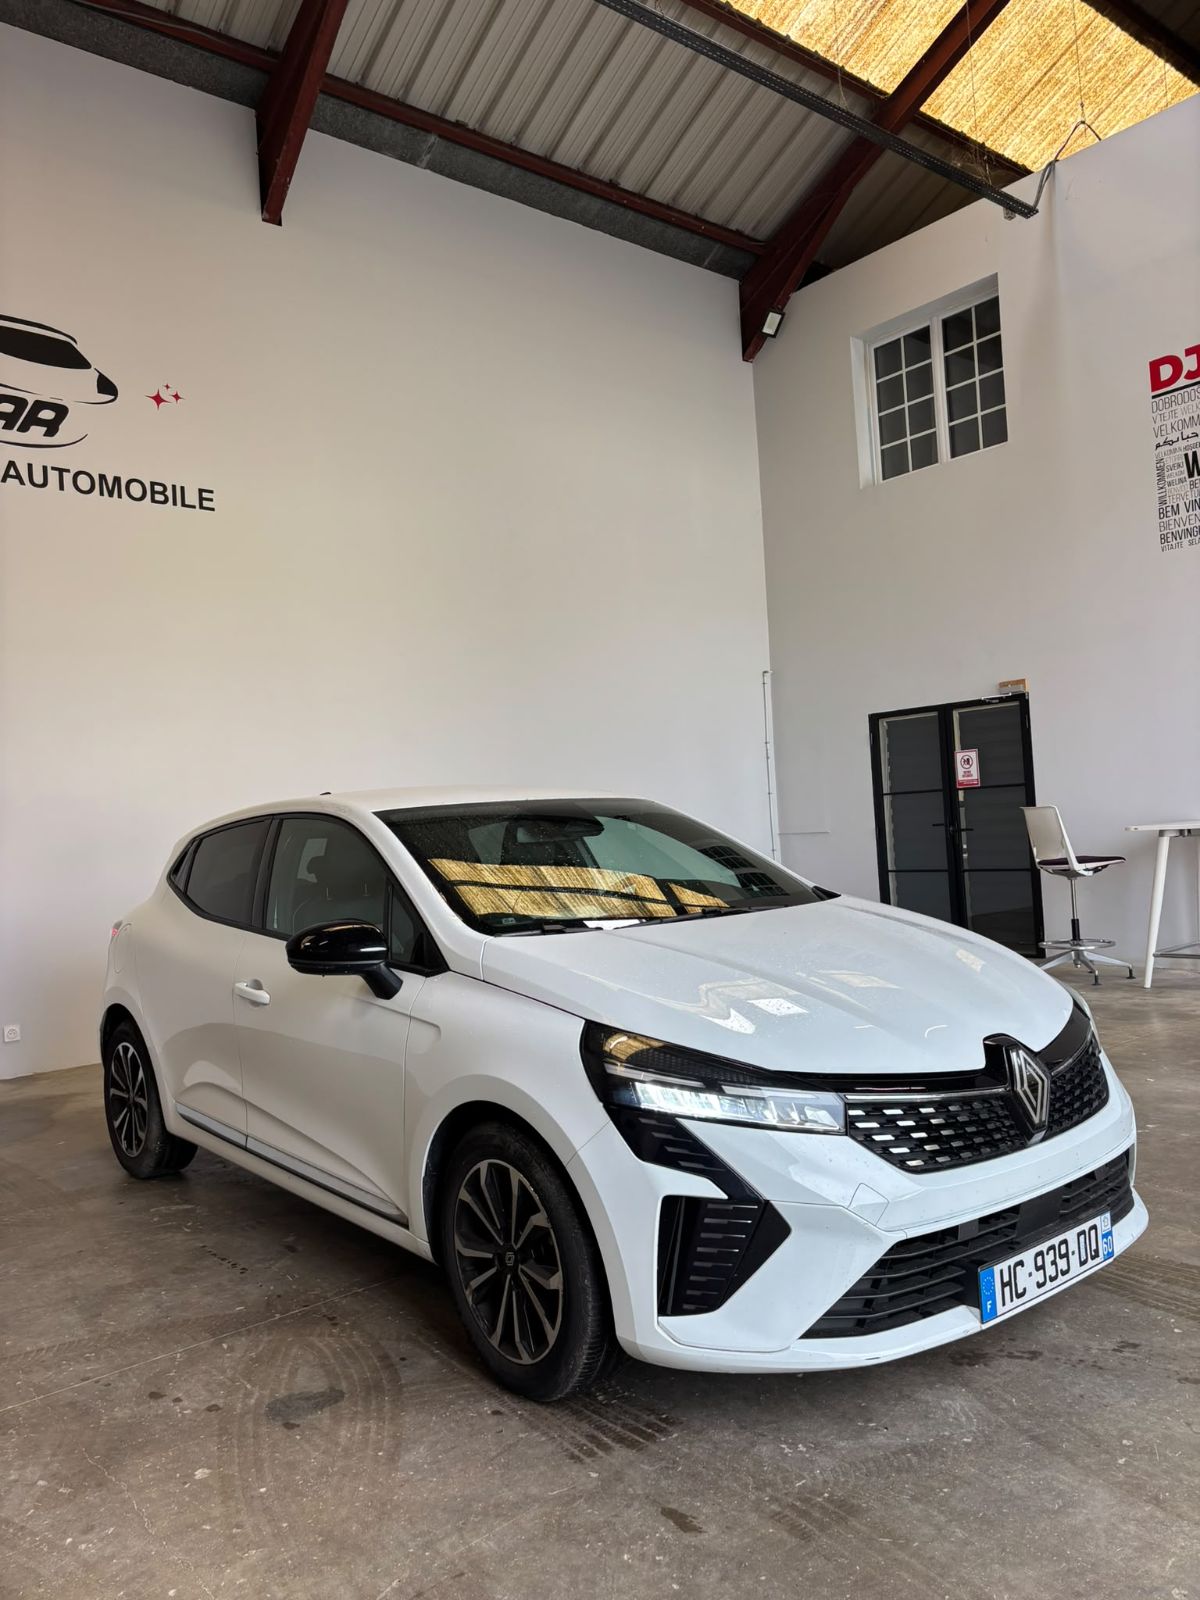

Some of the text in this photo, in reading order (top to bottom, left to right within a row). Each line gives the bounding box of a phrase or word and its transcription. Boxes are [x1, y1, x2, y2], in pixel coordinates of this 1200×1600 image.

[1, 460, 215, 512] AUTOMOBILE
[1155, 458, 1167, 506] WILLKOMMEN
[1159, 503, 1180, 520] BEM
[1102, 1236, 1113, 1255] 60
[986, 1300, 992, 1313] F
